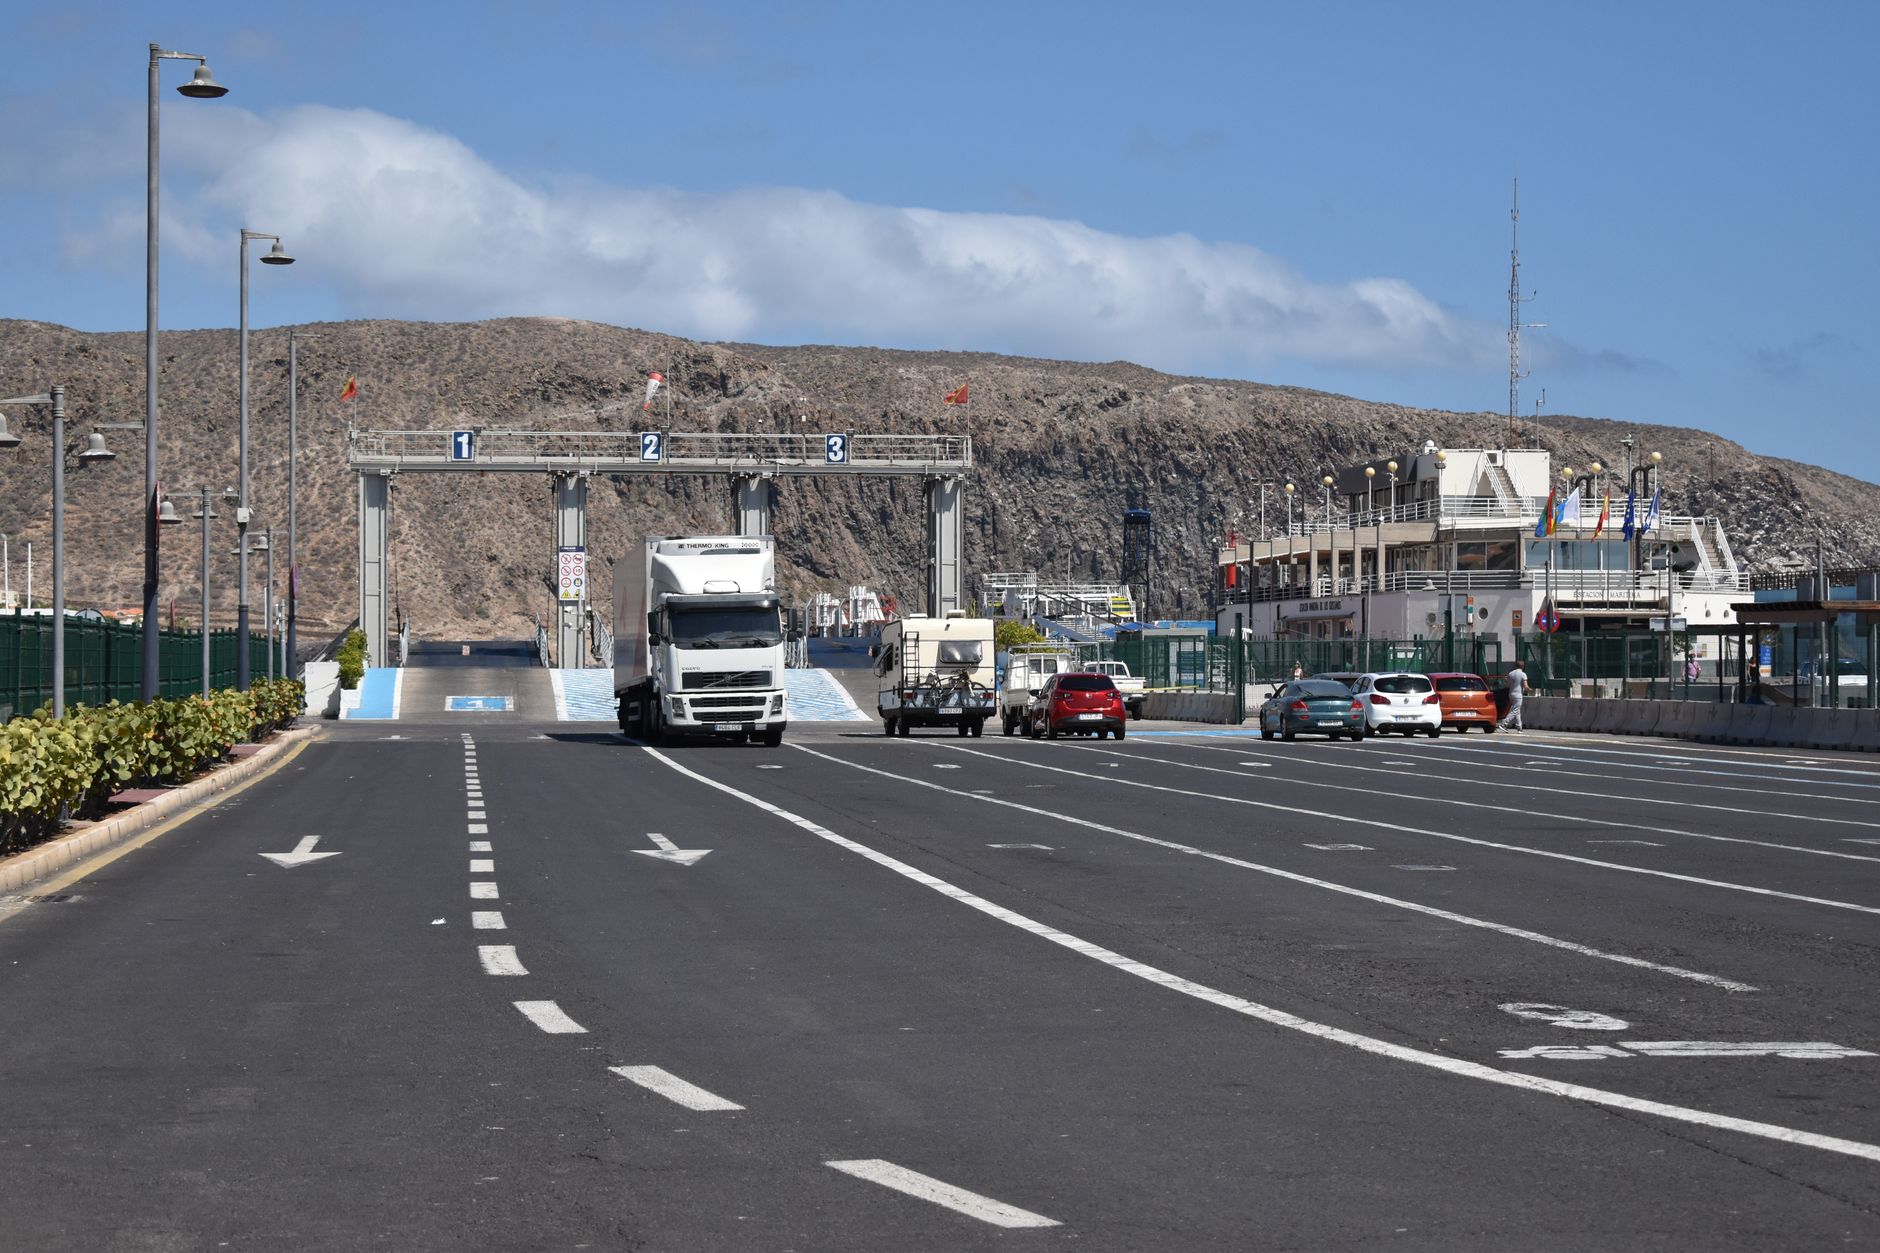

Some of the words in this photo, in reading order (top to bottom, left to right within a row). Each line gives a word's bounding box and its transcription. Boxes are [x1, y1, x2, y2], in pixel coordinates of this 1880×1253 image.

[457, 433, 468, 458] 1
[644, 435, 658, 459] 2
[828, 436, 843, 461] 3
